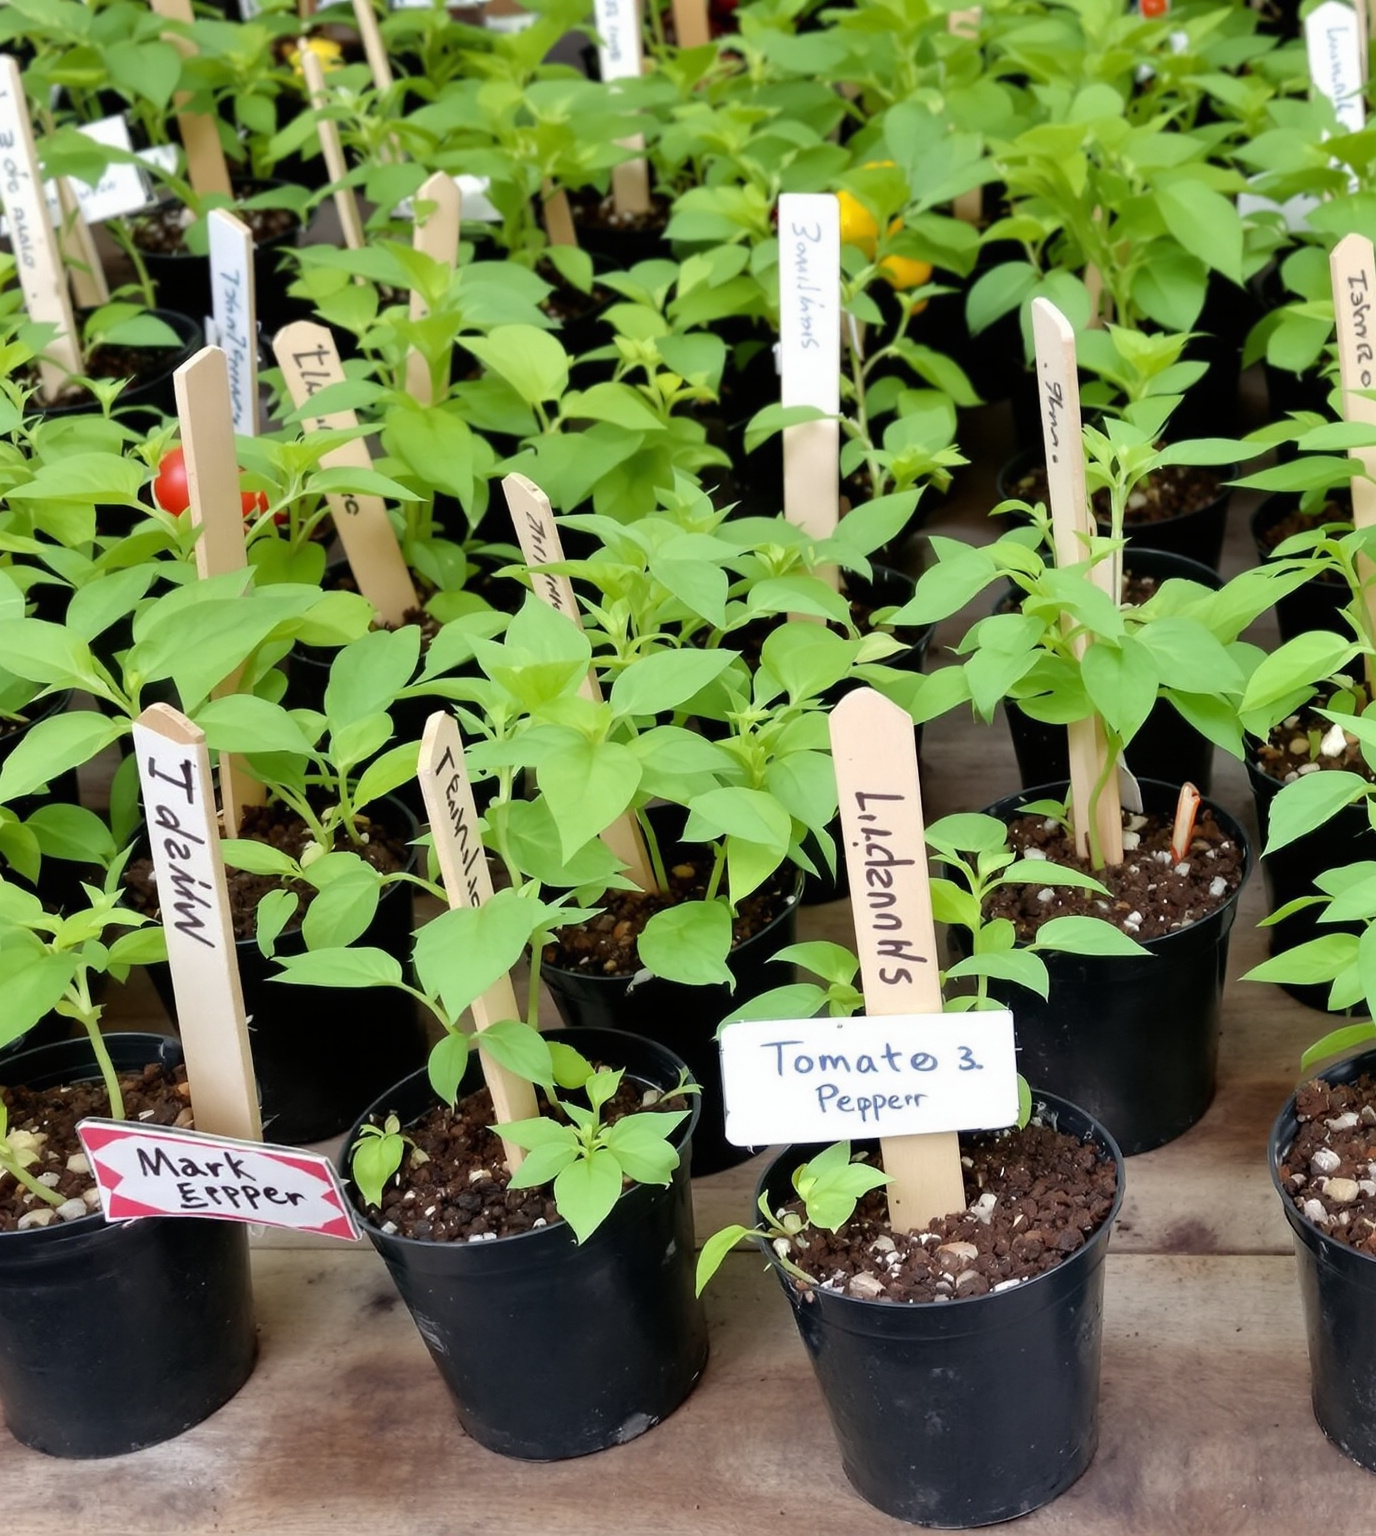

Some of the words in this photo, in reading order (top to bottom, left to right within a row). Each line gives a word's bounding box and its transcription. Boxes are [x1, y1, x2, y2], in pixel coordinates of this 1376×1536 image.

[760, 1040, 938, 1076] Tomato
[814, 1083, 929, 1122] Pepperr
[136, 1147, 256, 1181] Mark
